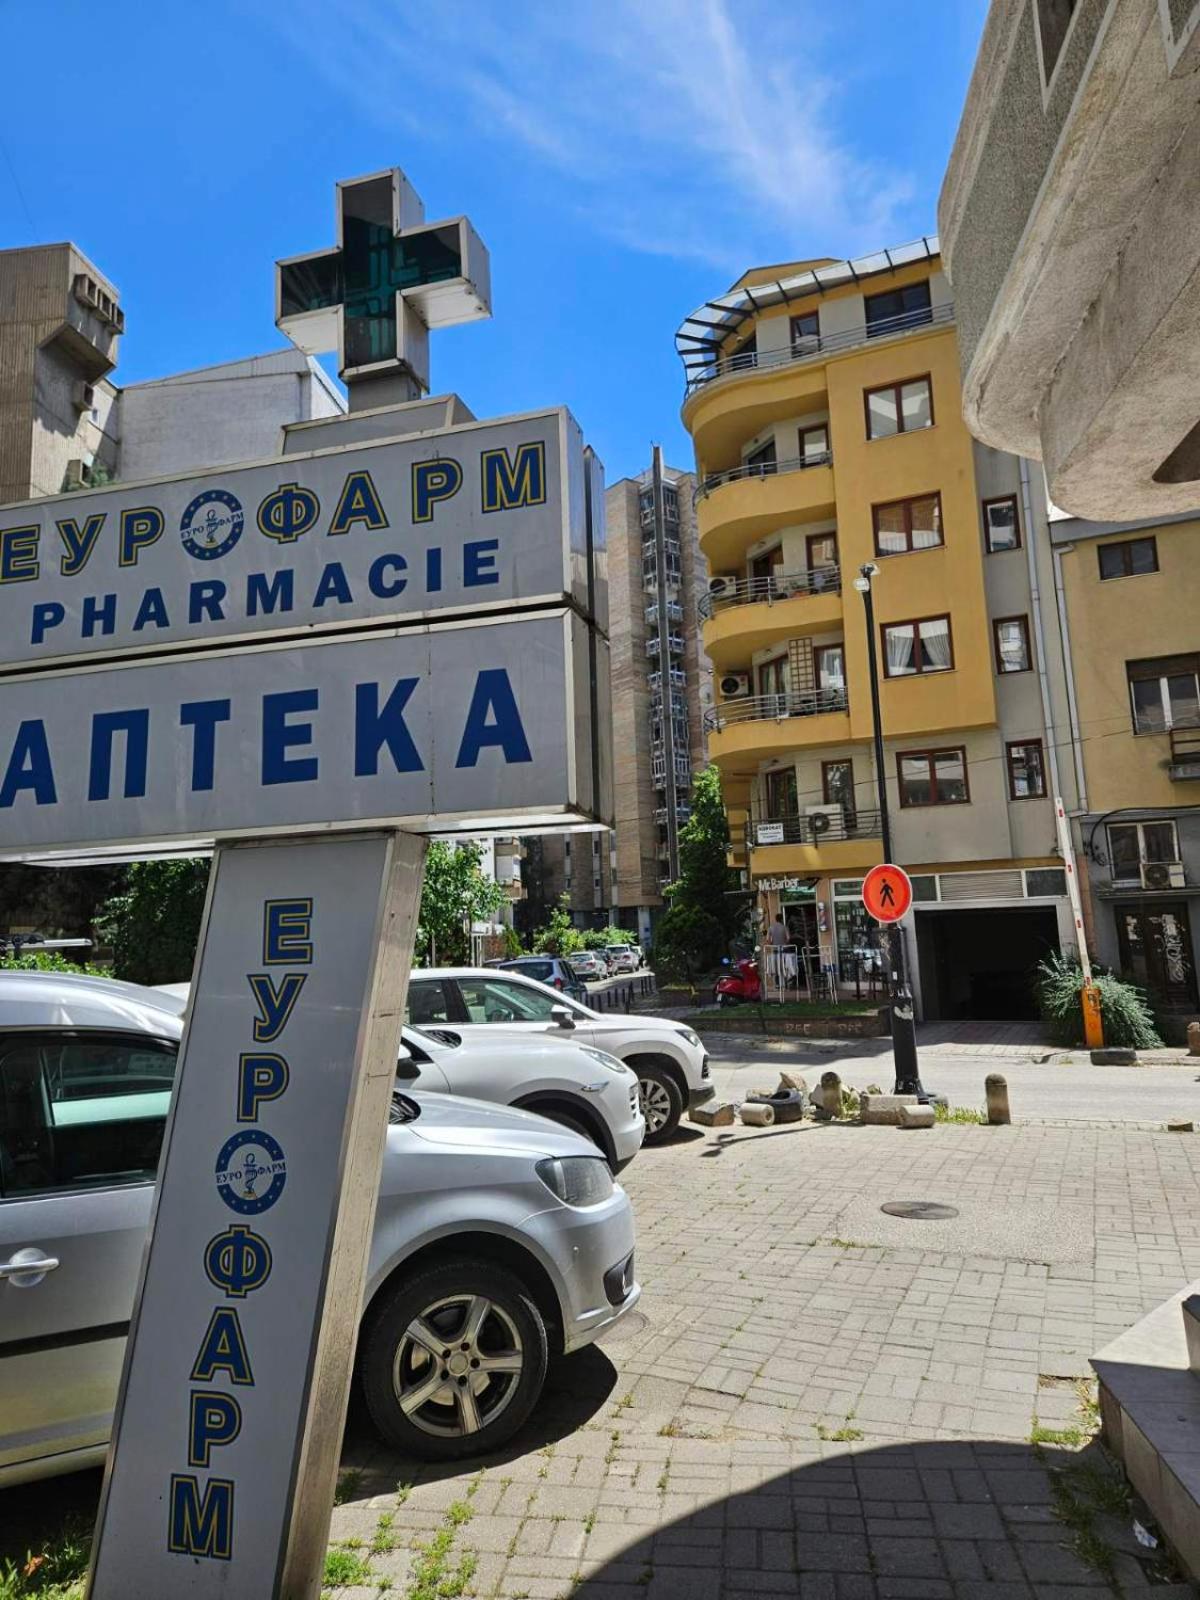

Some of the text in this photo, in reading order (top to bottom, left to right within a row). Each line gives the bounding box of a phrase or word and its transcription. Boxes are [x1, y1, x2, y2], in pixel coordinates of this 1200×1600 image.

[30, 539, 500, 644] PHARMACIE
[0, 668, 533, 808] АПТЕКА
[216, 1162, 286, 1184] ЕУРО ФАРМ
